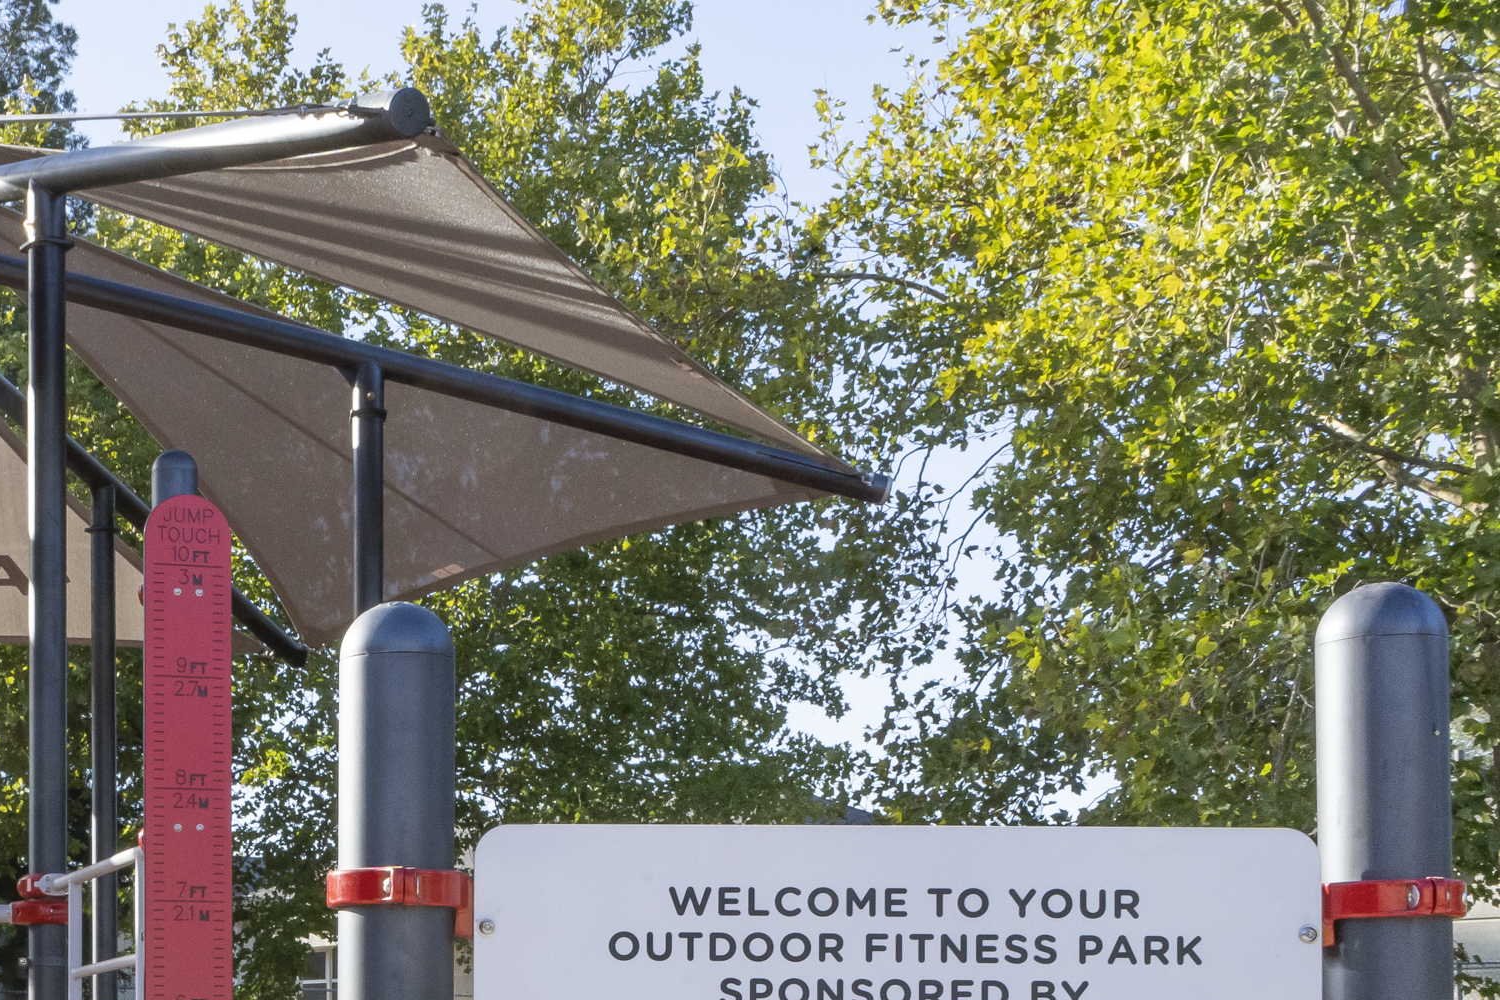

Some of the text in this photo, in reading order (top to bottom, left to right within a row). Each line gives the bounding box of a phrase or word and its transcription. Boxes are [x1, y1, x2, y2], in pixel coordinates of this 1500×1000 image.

[163, 507, 214, 524] JUMP
[158, 525, 220, 544] TOUCH
[172, 546, 209, 563] 10 FT
[178, 569, 202, 586] 3 M
[177, 658, 207, 674] 9 FT
[176, 770, 207, 786] 8 FT
[177, 882, 207, 898] 7 FT
[669, 887, 1141, 919] WELCOME TO YOUR
[174, 906, 209, 921] 2.1 M
[608, 932, 1203, 966] OUTDOOR FITNESS PARK
